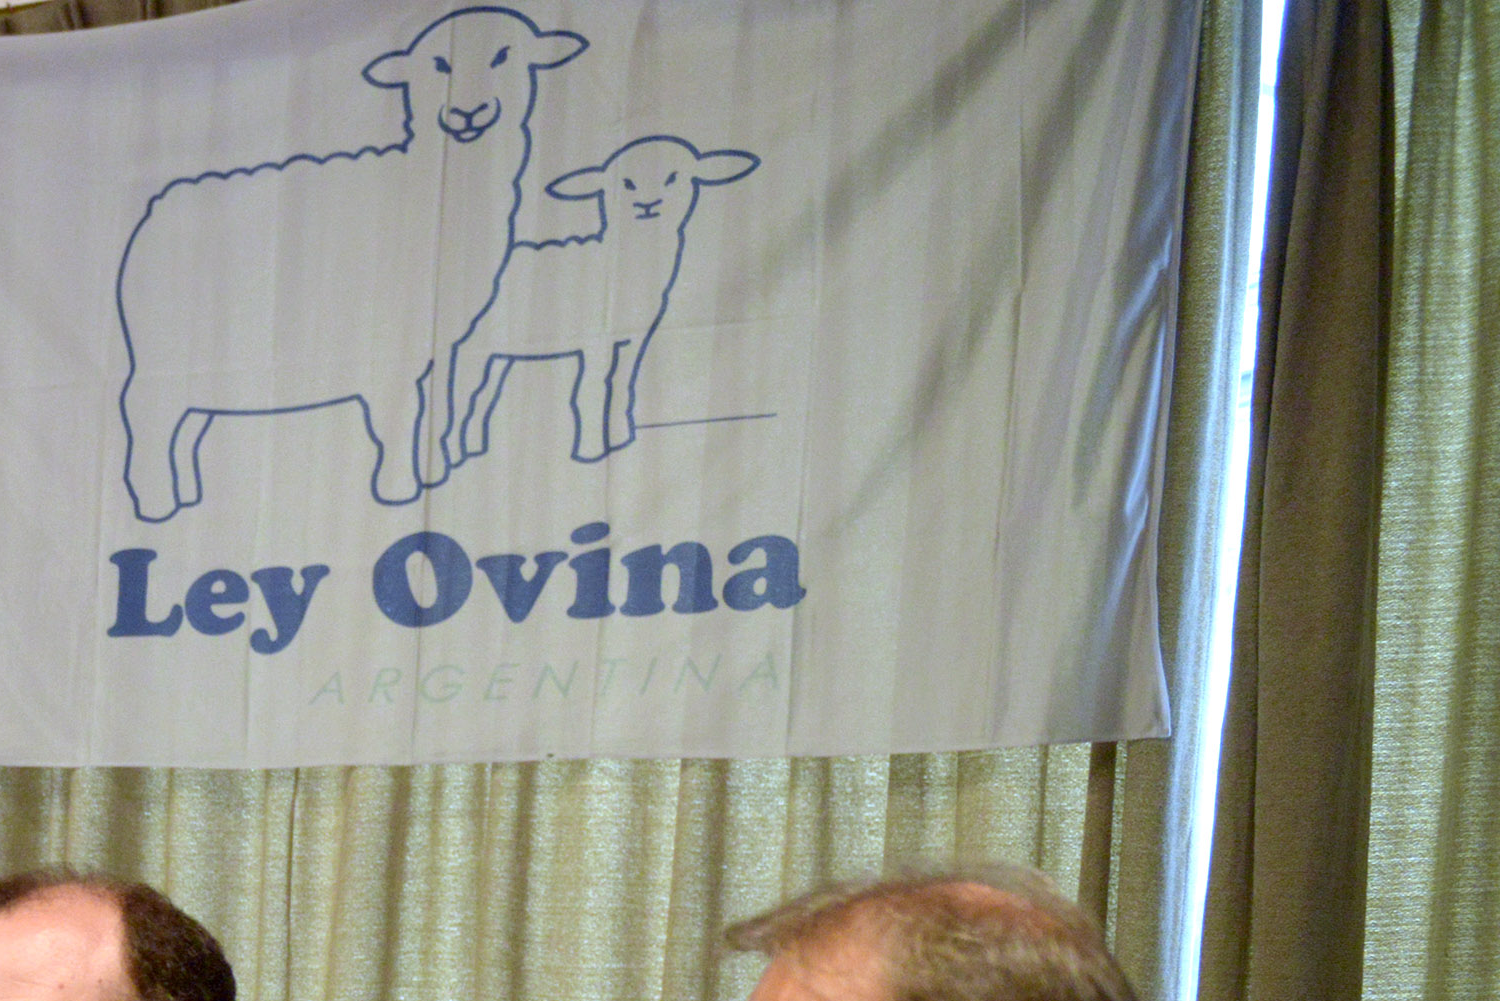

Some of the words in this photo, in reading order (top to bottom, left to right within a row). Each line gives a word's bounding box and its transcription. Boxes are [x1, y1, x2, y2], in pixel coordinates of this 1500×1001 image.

[108, 547, 330, 655] Ley
[372, 522, 807, 627] Ovina
[308, 653, 781, 706] ARGENTINA
